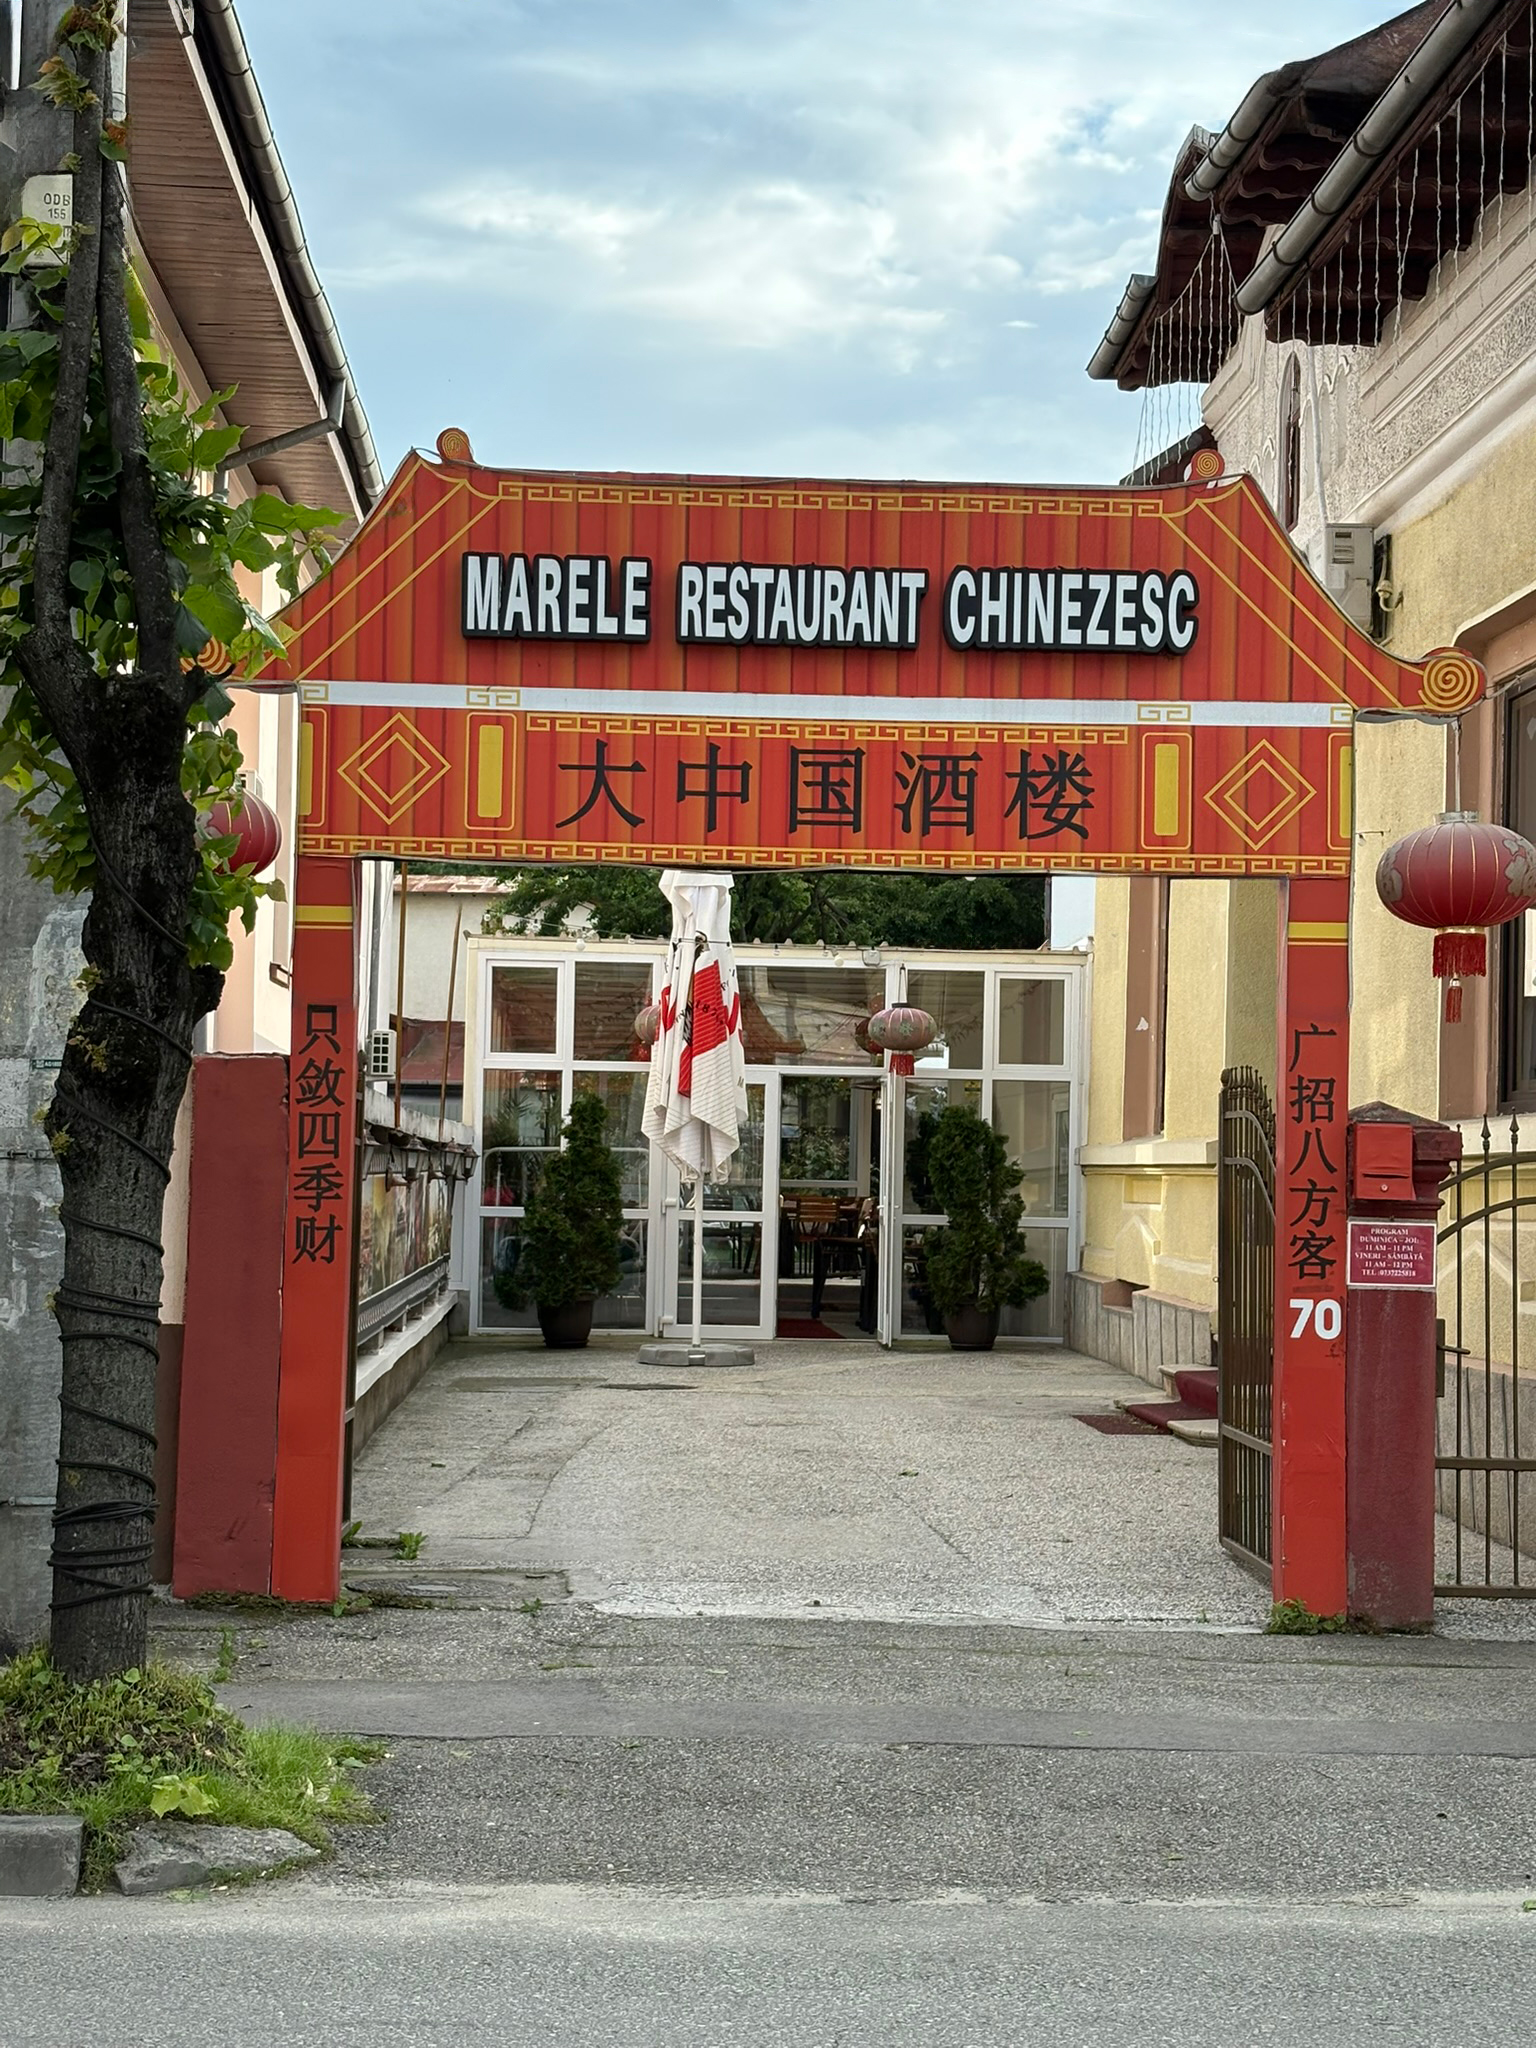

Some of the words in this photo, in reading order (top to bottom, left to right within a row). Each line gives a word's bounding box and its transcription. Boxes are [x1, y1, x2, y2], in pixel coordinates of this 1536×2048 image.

[43, 192, 71, 207] ODB
[47, 208, 67, 220] 155
[465, 554, 649, 637] MARELE
[679, 563, 926, 645] RESTAURANT
[949, 569, 1196, 649] CHINEZESC
[554, 737, 1096, 841] 大中国酒楼
[292, 1003, 346, 1265] 只敛四季财
[1288, 1022, 1338, 1281] 广招八方客
[1289, 1298, 1342, 1340] 70
